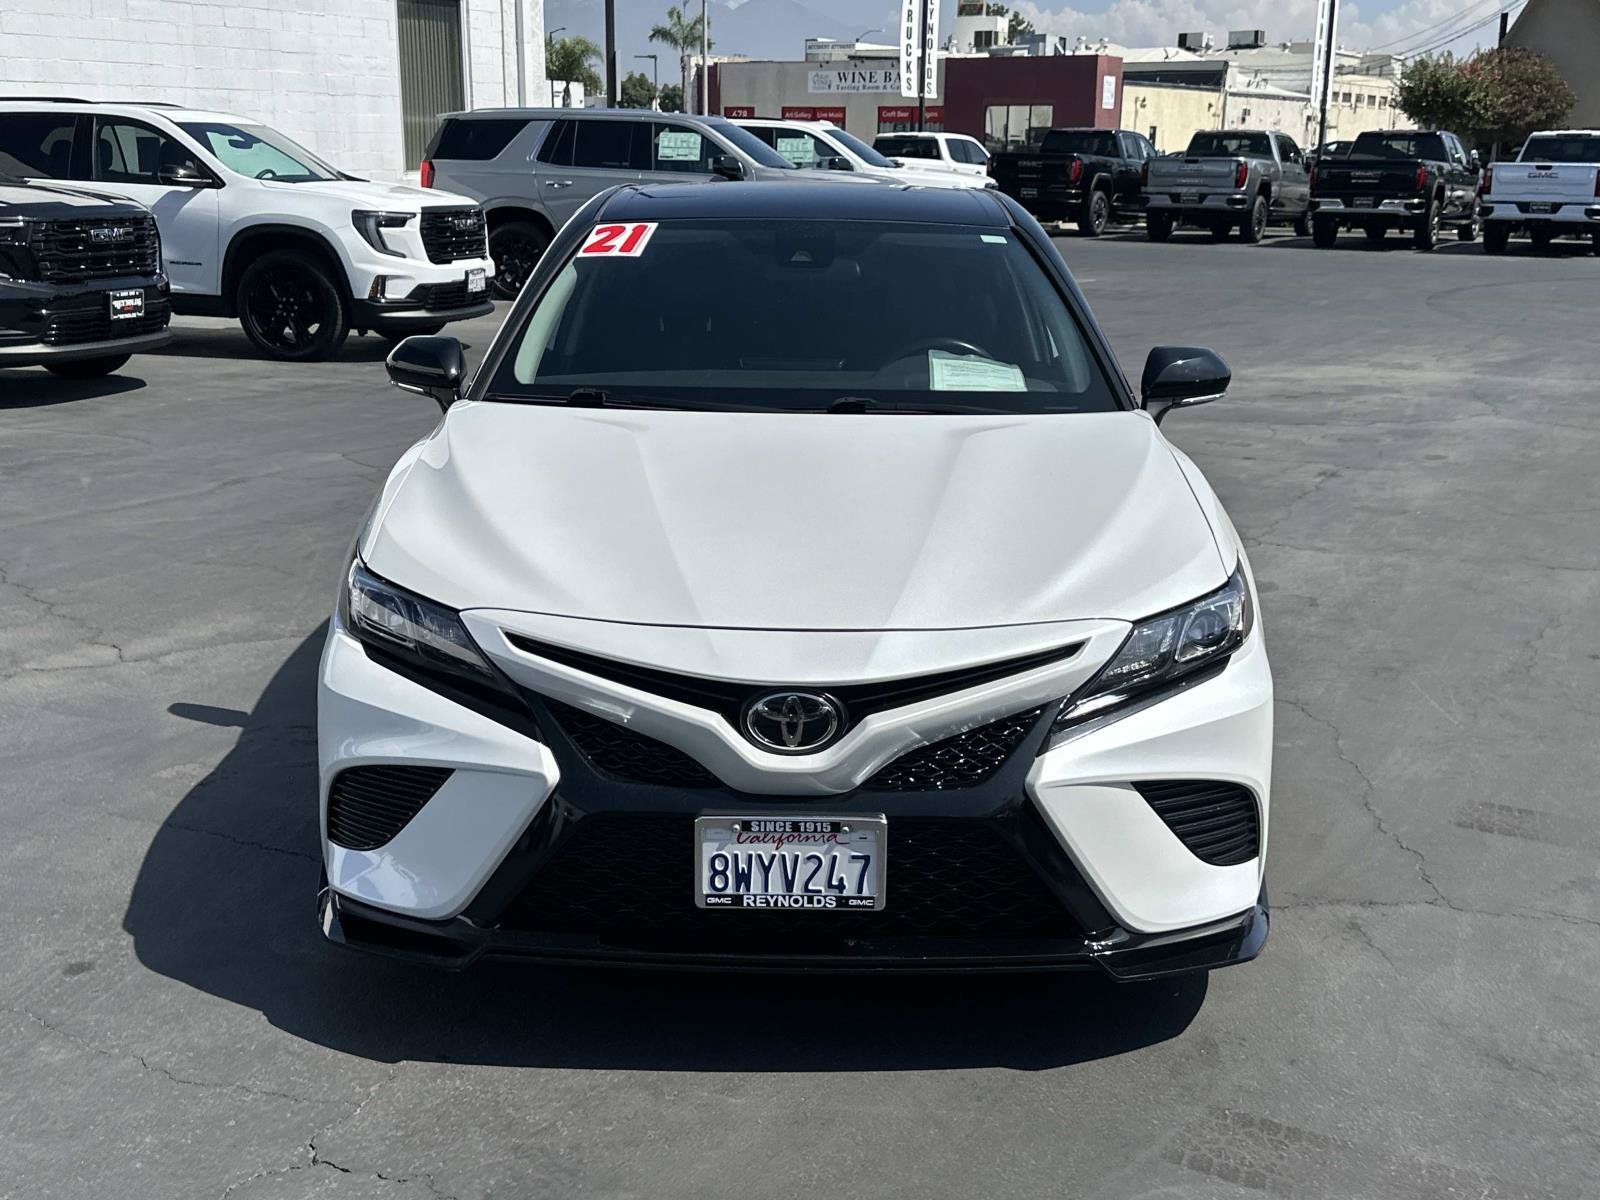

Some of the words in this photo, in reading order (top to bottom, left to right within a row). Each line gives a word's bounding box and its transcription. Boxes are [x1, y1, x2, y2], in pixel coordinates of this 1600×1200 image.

[837, 71, 878, 84] WINE
[883, 71, 901, 84] BA
[89, 228, 134, 242] GMC
[582, 224, 651, 254] 21
[750, 821, 792, 832] SINCE
[799, 822, 832, 833] 1915
[709, 852, 871, 895] 8WYV247
[743, 895, 837, 908] REYNOLDS
[848, 898, 874, 906] GMC
